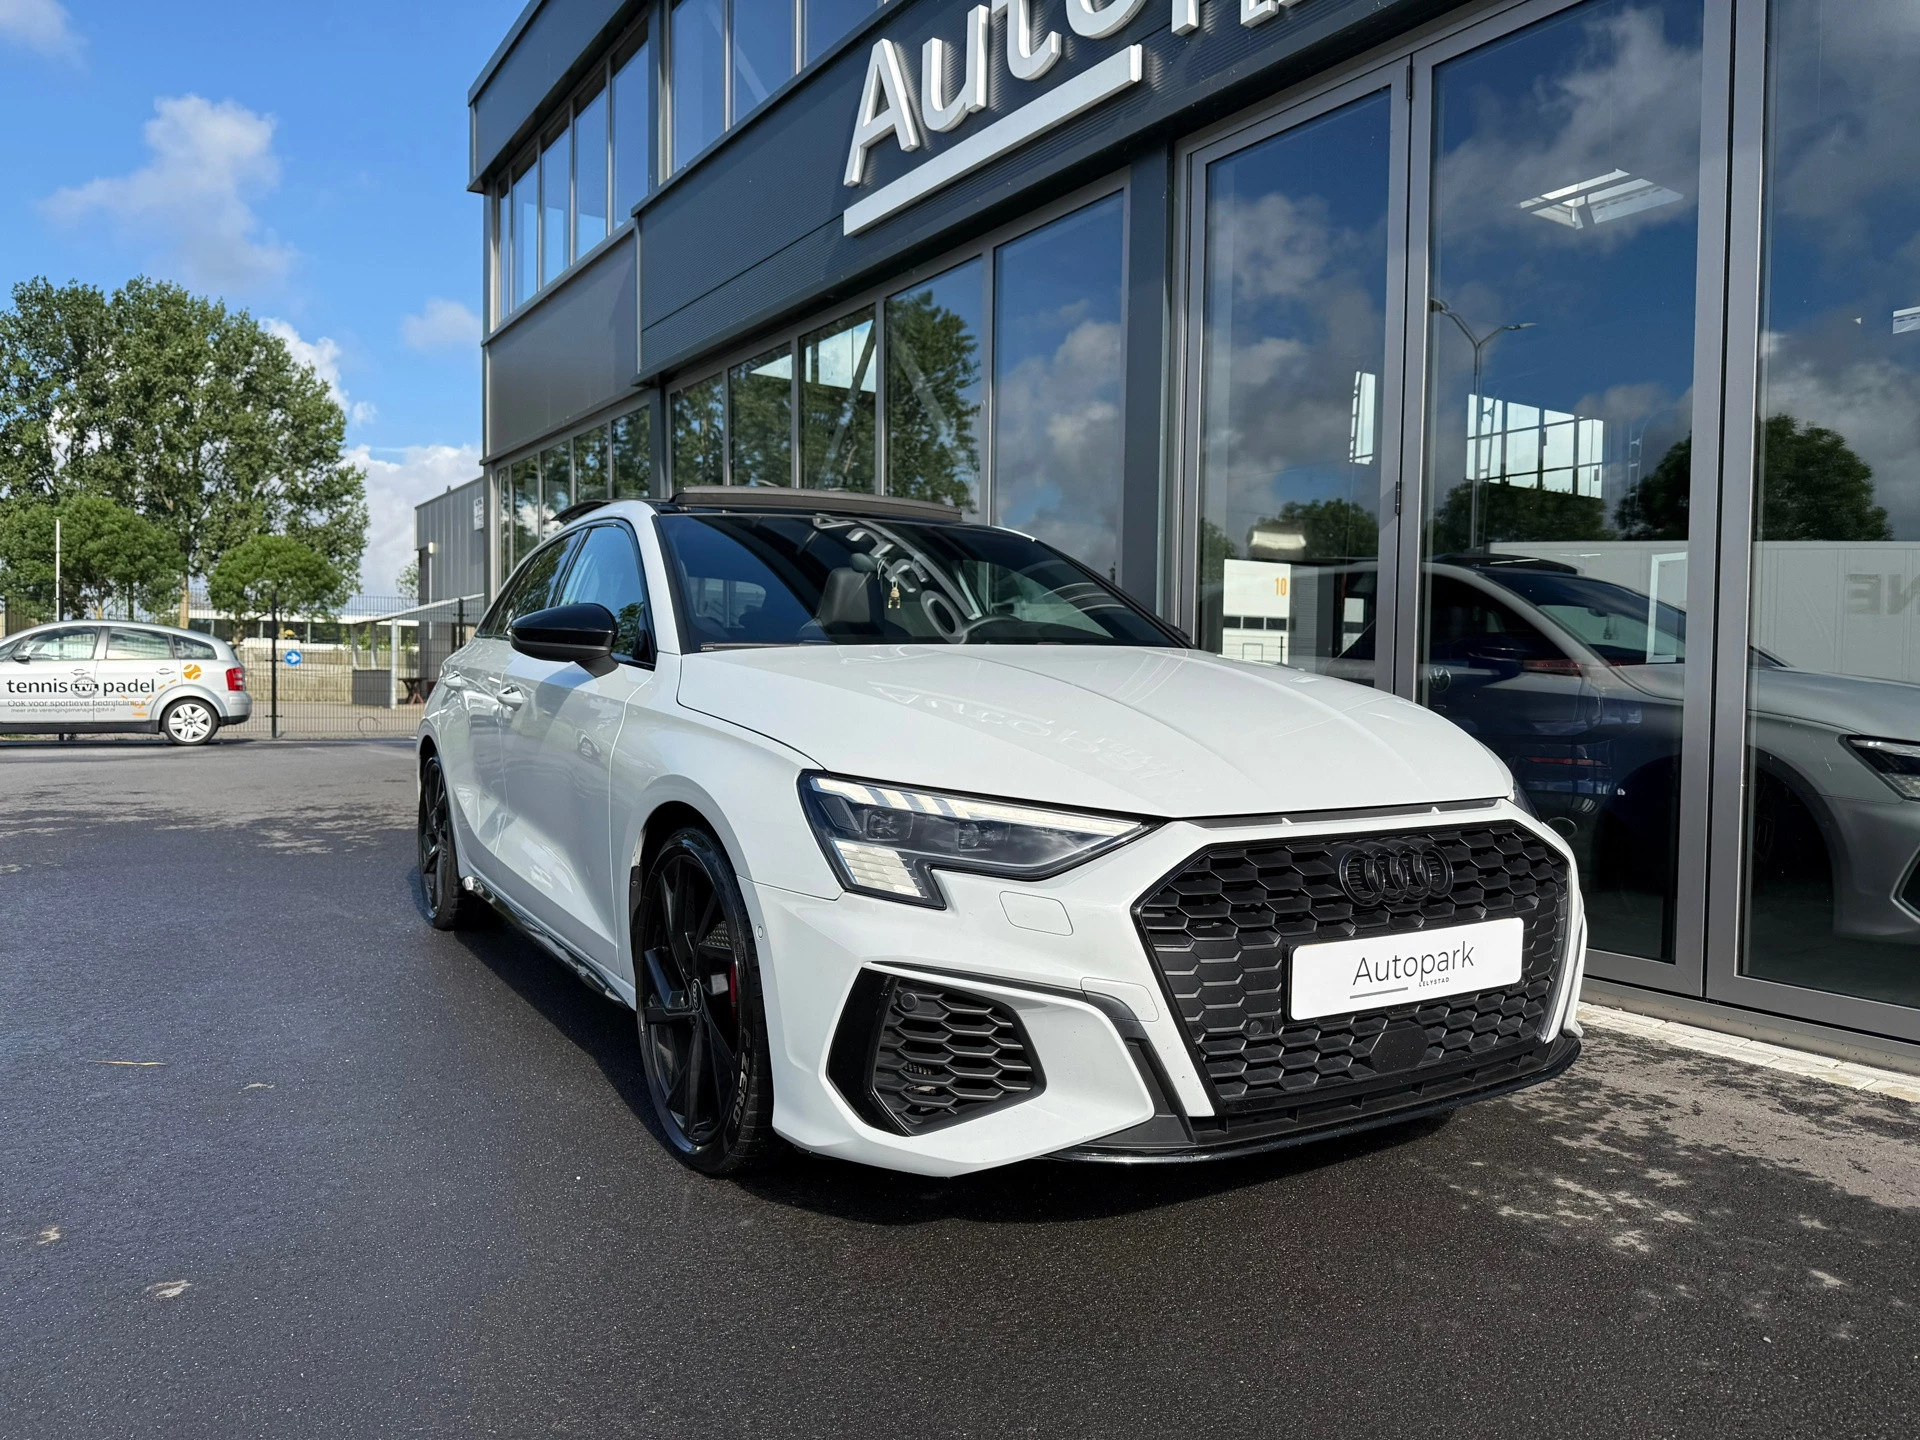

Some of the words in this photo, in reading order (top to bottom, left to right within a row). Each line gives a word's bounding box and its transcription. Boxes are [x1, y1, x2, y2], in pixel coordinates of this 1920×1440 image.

[1274, 577, 1287, 596] 10
[6, 678, 68, 693] tennis
[103, 678, 155, 697] padel
[49, 700, 89, 708] sportieve
[1352, 941, 1475, 986] Autopark
[1418, 976, 1450, 988] LELYSTAD
[732, 1051, 750, 1126] ZERO
